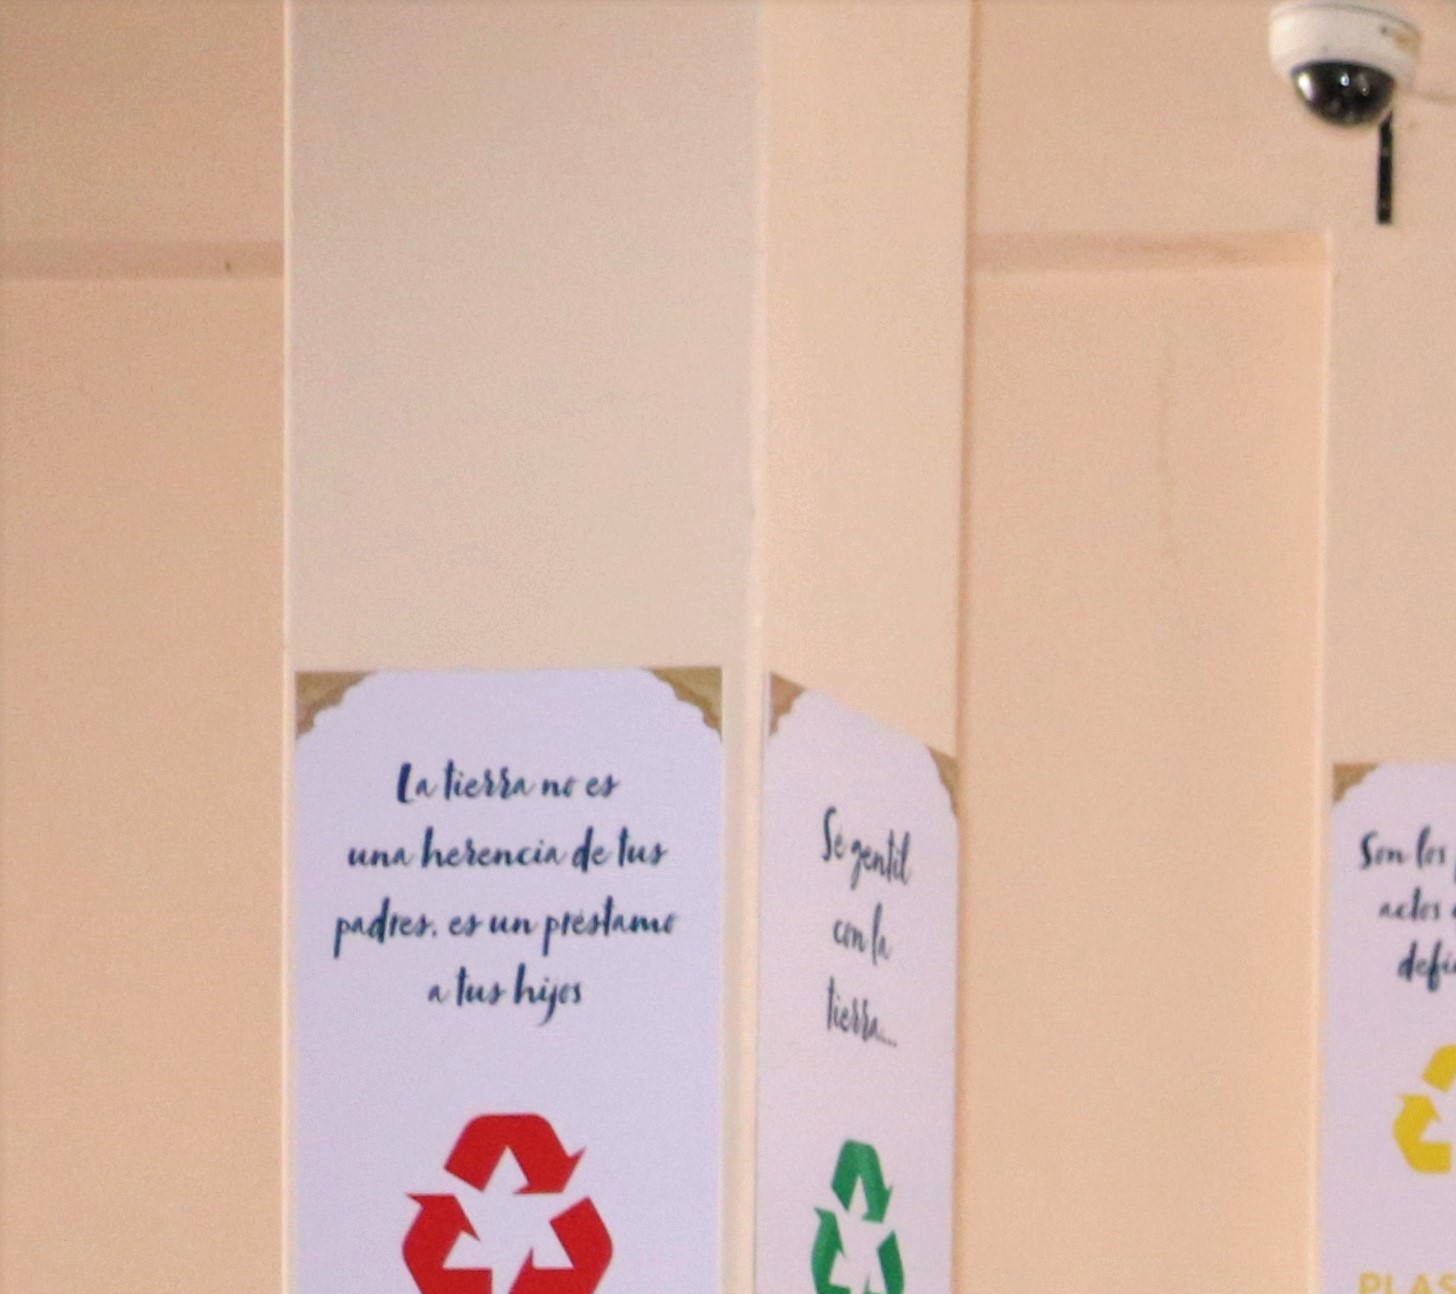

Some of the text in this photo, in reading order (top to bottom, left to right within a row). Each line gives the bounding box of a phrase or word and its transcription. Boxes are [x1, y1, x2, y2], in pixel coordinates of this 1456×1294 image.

[397, 758, 620, 804] La tierra no es
[346, 825, 668, 873] una herencia de tus
[850, 828, 911, 890] gentil
[1360, 829, 1404, 871] Son
[1417, 825, 1446, 868] los
[447, 914, 483, 938] es
[488, 912, 537, 938] un
[1378, 886, 1441, 921] actos
[833, 901, 892, 966] con la
[428, 962, 582, 1027] a tus hijos
